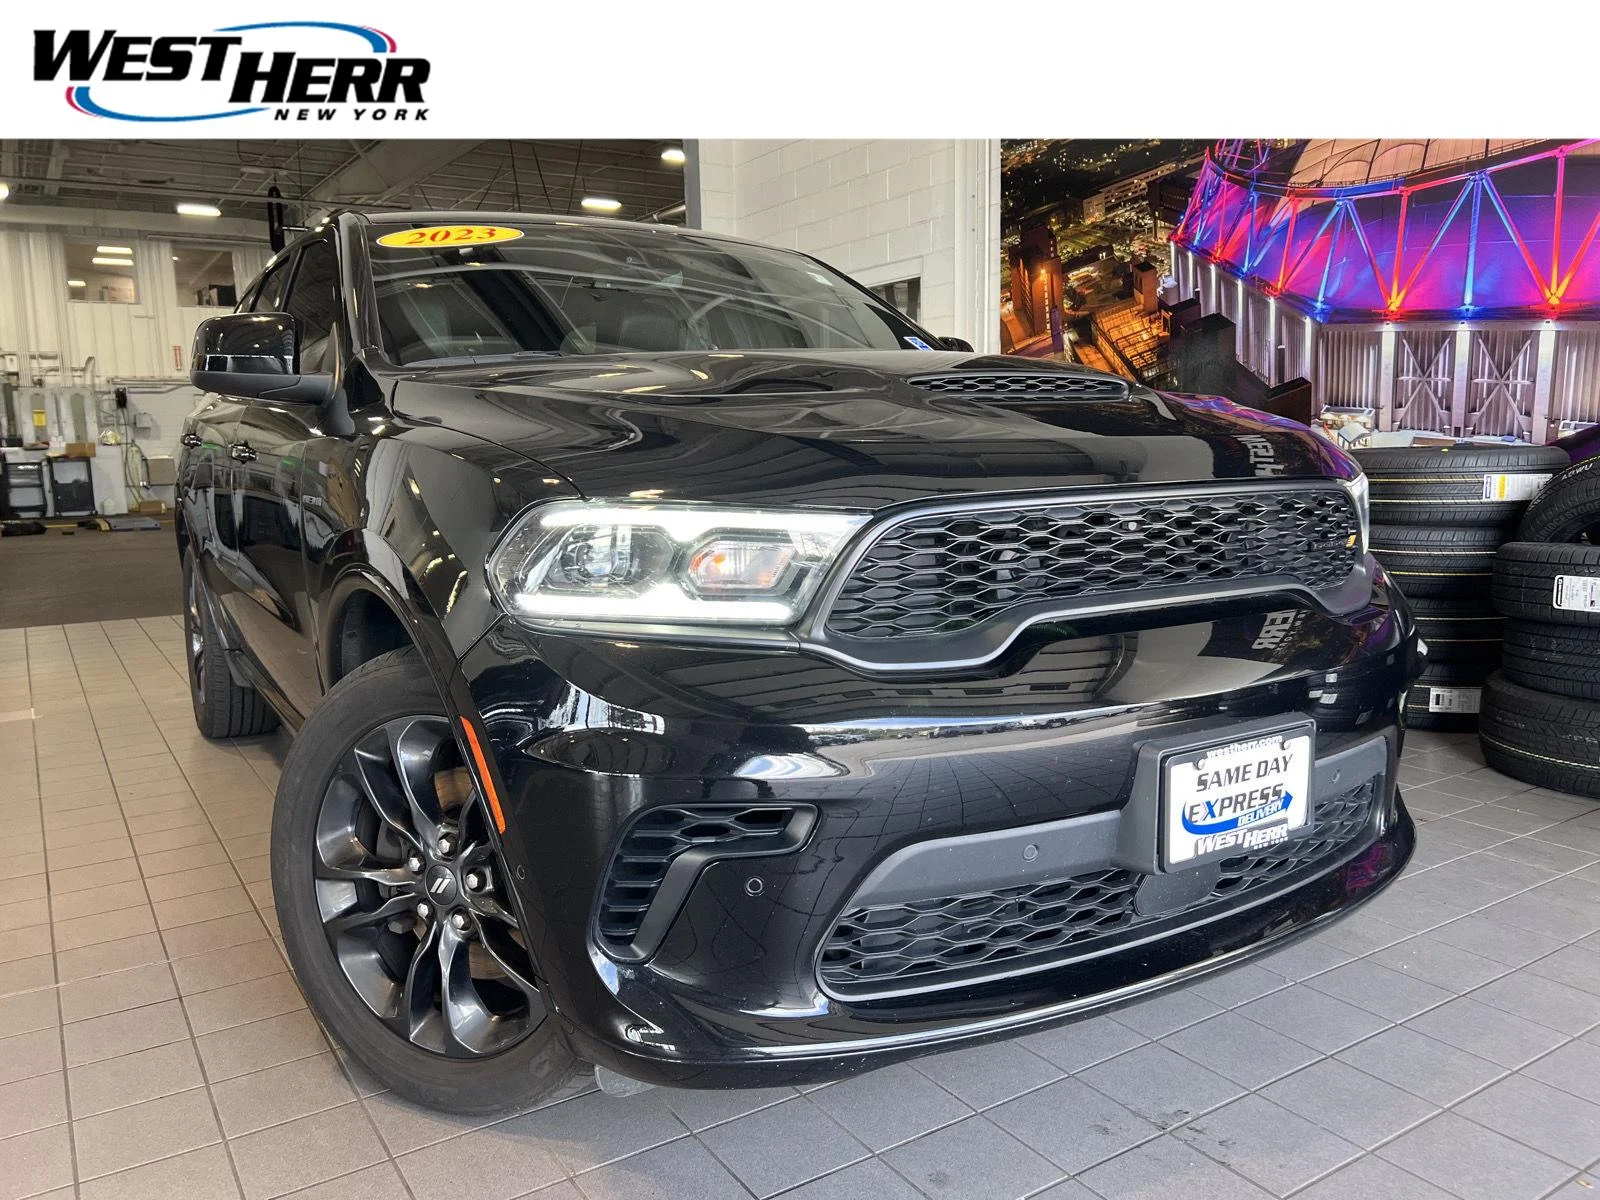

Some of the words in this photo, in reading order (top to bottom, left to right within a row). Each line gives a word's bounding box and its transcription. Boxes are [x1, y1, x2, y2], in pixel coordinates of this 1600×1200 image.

[406, 228, 496, 244] 2023
[1196, 763, 1252, 792] SAME
[1256, 753, 1293, 779] DAY
[1188, 783, 1284, 823] EXPRESS
[1237, 799, 1285, 827] DELIVERY
[1197, 829, 1248, 855] WEST
[1243, 823, 1288, 848] HERR
